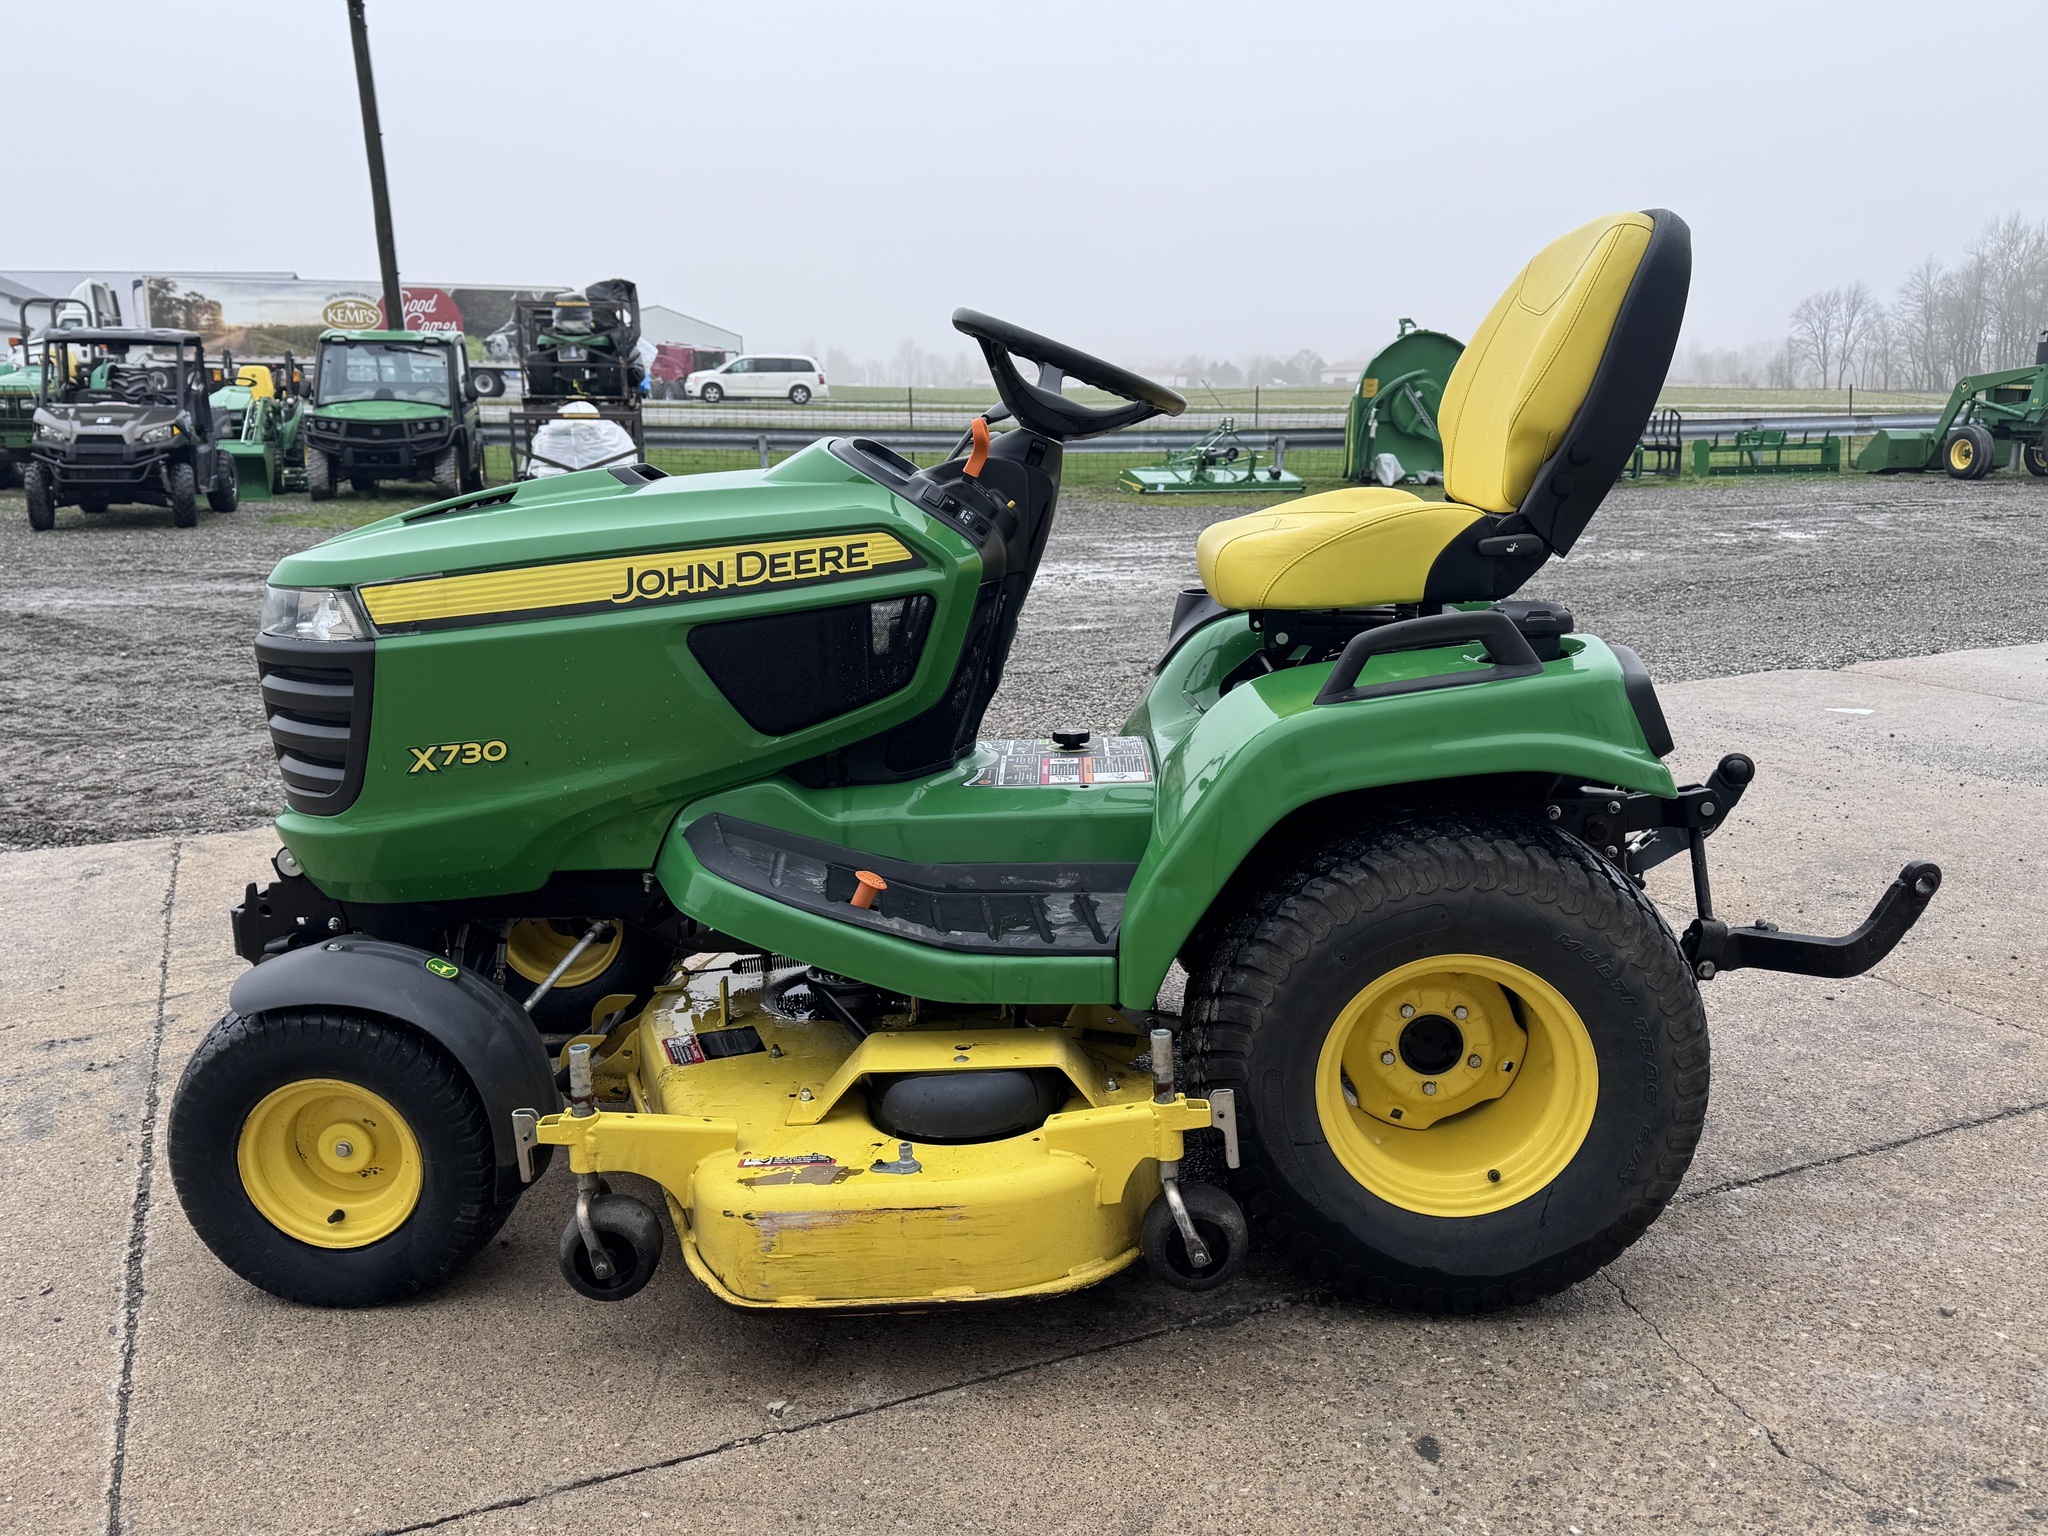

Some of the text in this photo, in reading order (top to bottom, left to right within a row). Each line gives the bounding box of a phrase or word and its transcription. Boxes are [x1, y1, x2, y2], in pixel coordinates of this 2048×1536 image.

[327, 308, 377, 323] KEMPS
[611, 541, 870, 601] JOHN DEERE
[407, 740, 508, 774] X730
[1554, 932, 1636, 1004] MULTI
[1632, 1016, 1660, 1105] TRAC
